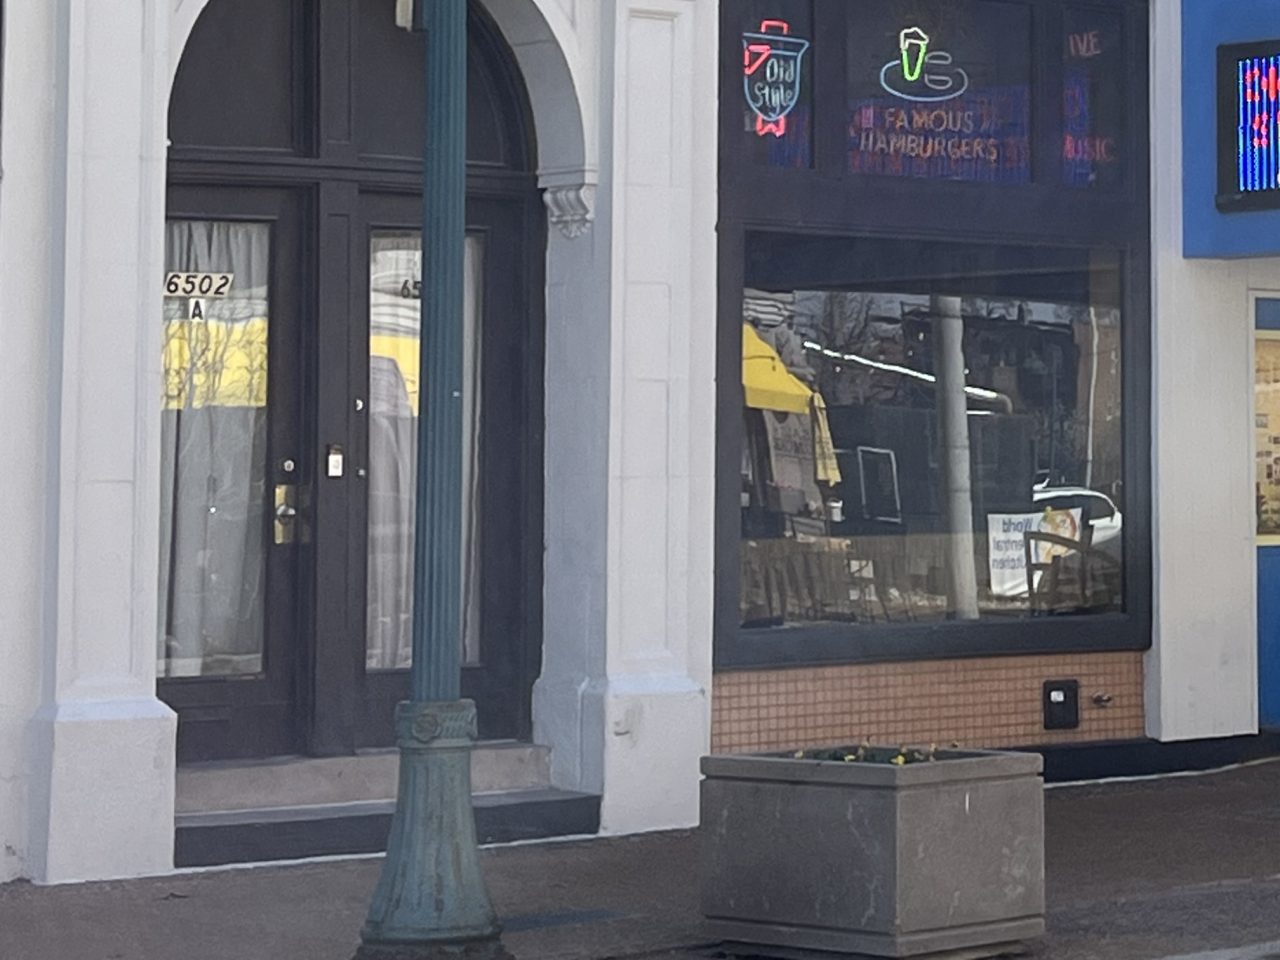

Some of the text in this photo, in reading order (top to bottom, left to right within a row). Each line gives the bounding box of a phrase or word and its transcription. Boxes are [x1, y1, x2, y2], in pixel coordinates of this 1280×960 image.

[753, 81, 795, 119] Style
[885, 107, 974, 133] FAMOUS
[859, 130, 998, 162] HAMBURGERS
[165, 273, 231, 296] 6502
[190, 299, 203, 320] A
